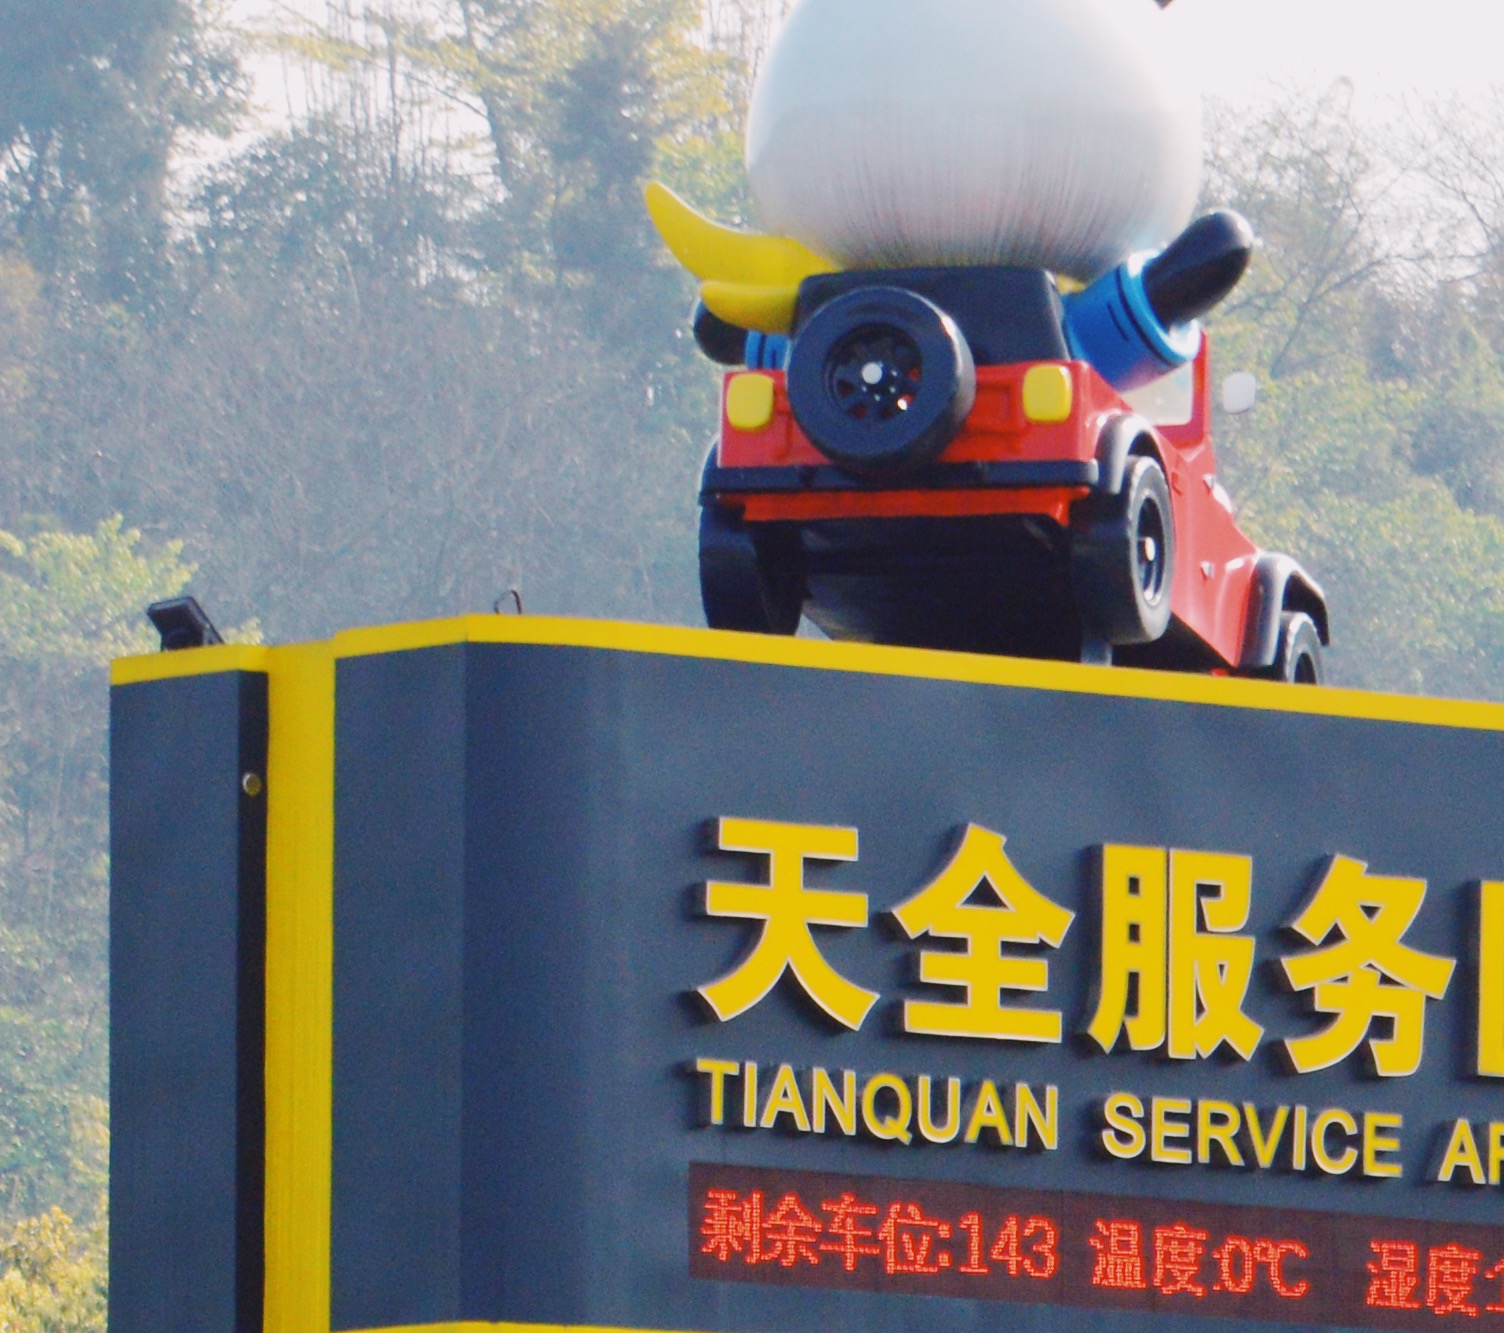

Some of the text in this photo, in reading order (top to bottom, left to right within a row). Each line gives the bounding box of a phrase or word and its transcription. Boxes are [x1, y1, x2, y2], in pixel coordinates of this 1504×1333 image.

[696, 1058, 1058, 1150] TIANQUAN
[1102, 1093, 1403, 1178] SERVICE
[700, 1188, 1058, 1279] 剩余车位:143
